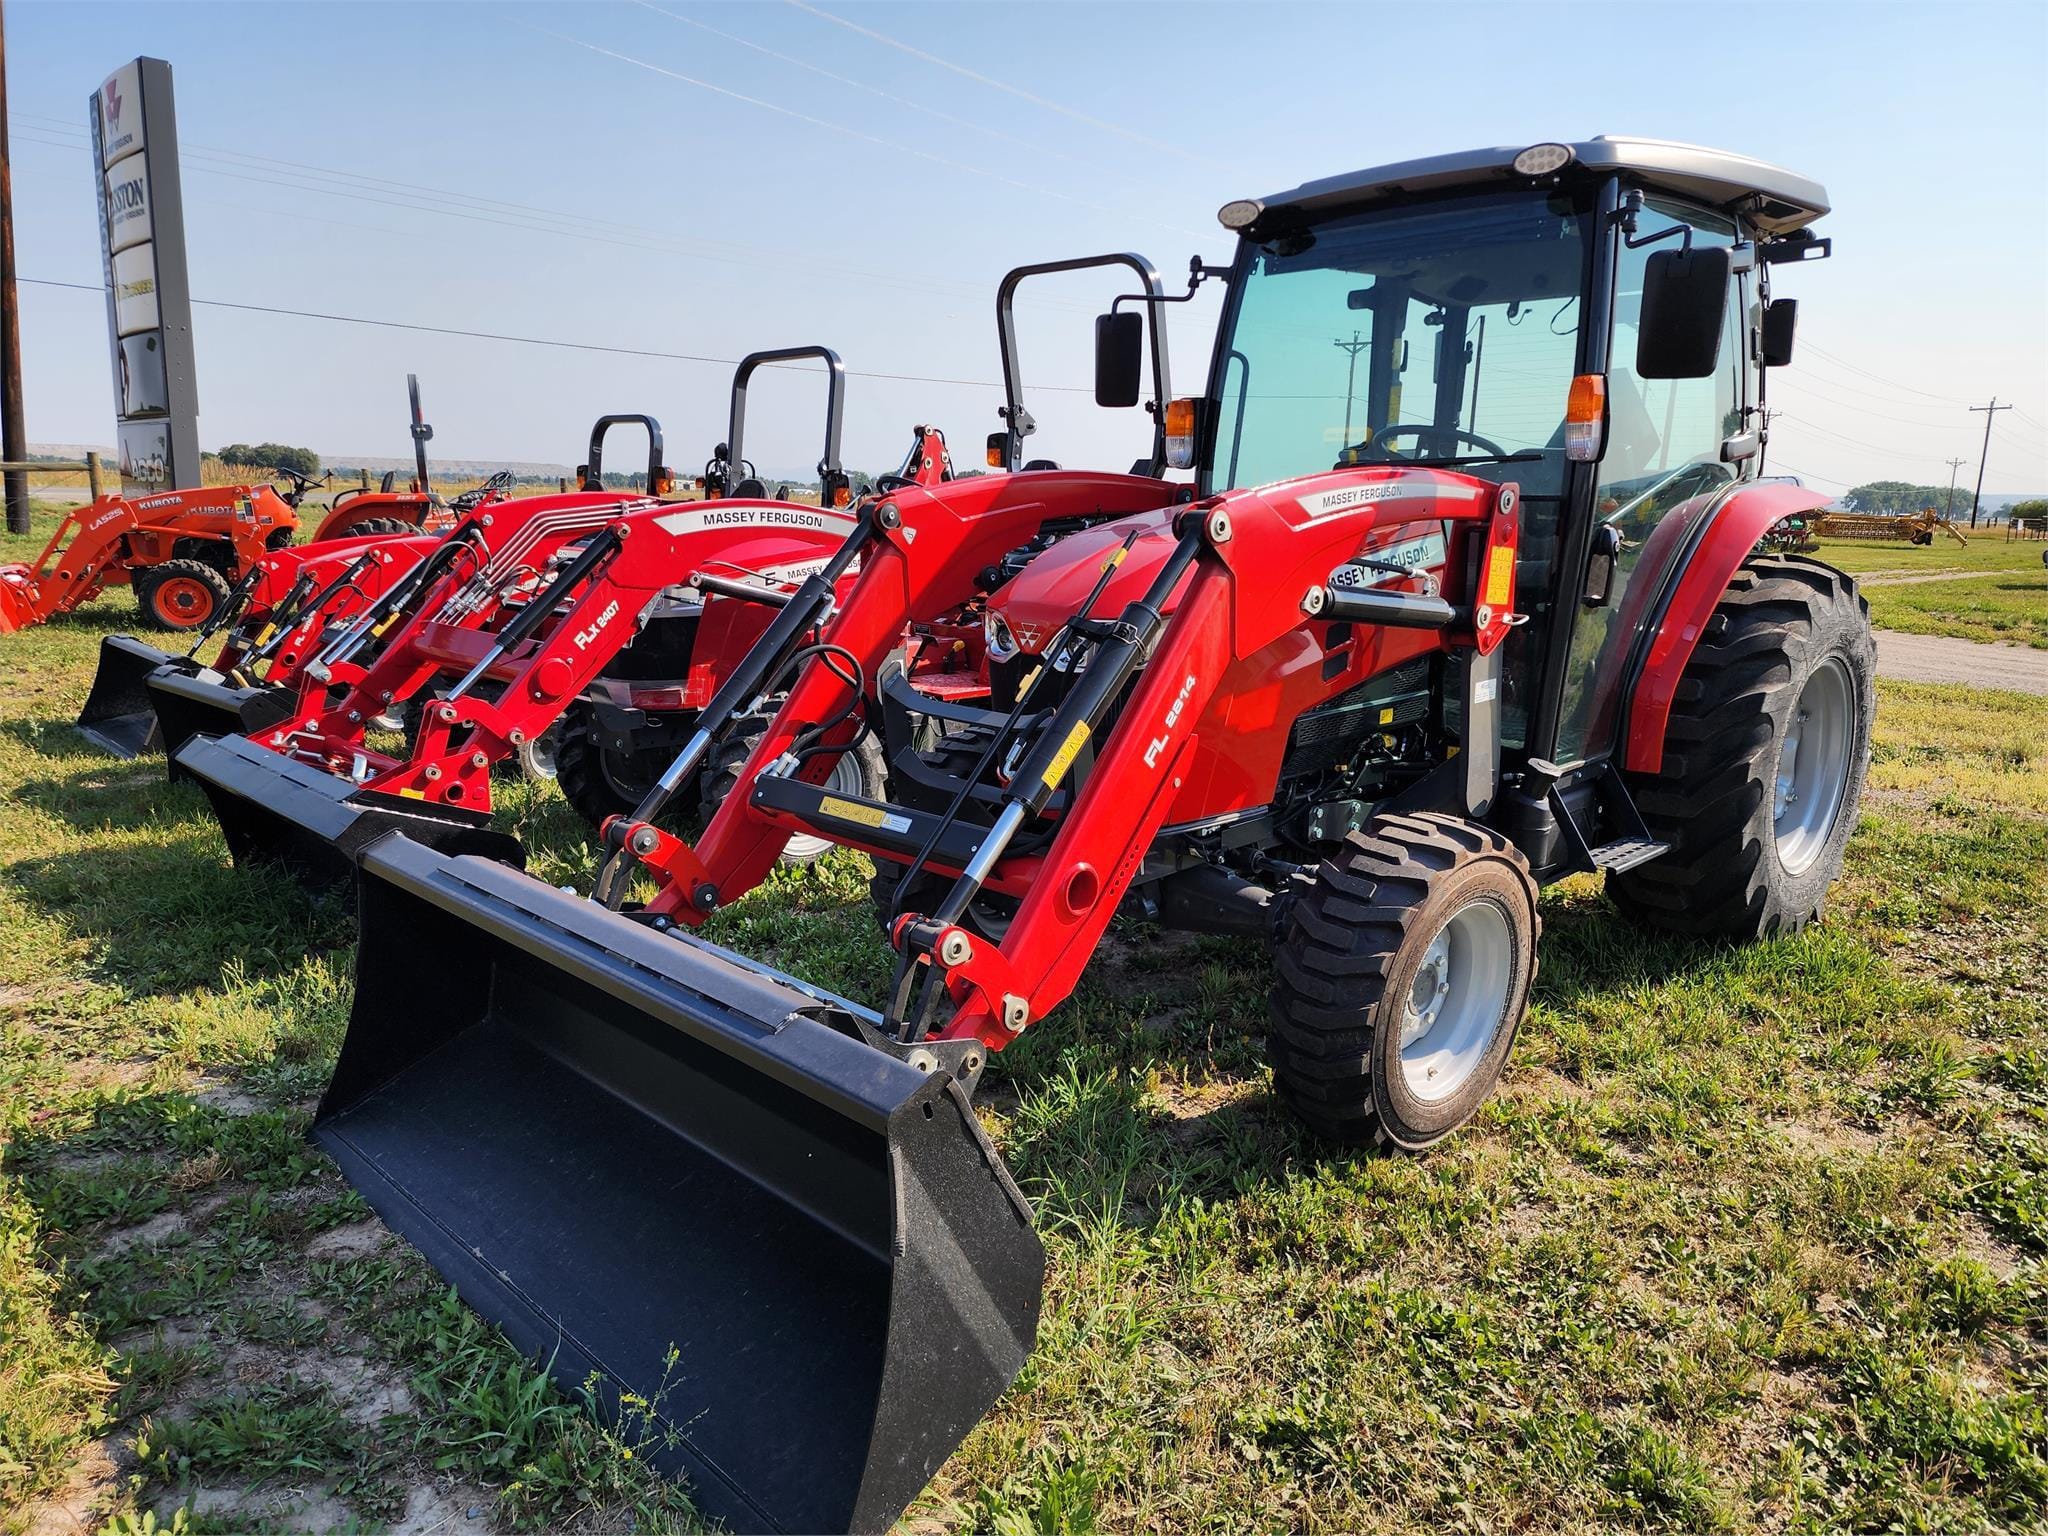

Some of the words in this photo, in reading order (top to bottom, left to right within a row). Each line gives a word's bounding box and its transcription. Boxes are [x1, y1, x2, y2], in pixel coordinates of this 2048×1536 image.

[139, 496, 182, 510] KUBOTA
[1322, 491, 1357, 508] MASSEY
[1360, 486, 1402, 501] FERGUSON
[703, 512, 755, 525] MASSEY
[760, 512, 823, 527] FERGUSON
[1327, 567, 1366, 587] ASSEY
[596, 599, 619, 628] 2407
[1144, 735, 1169, 769] FL
[1165, 675, 1196, 729] 2814
